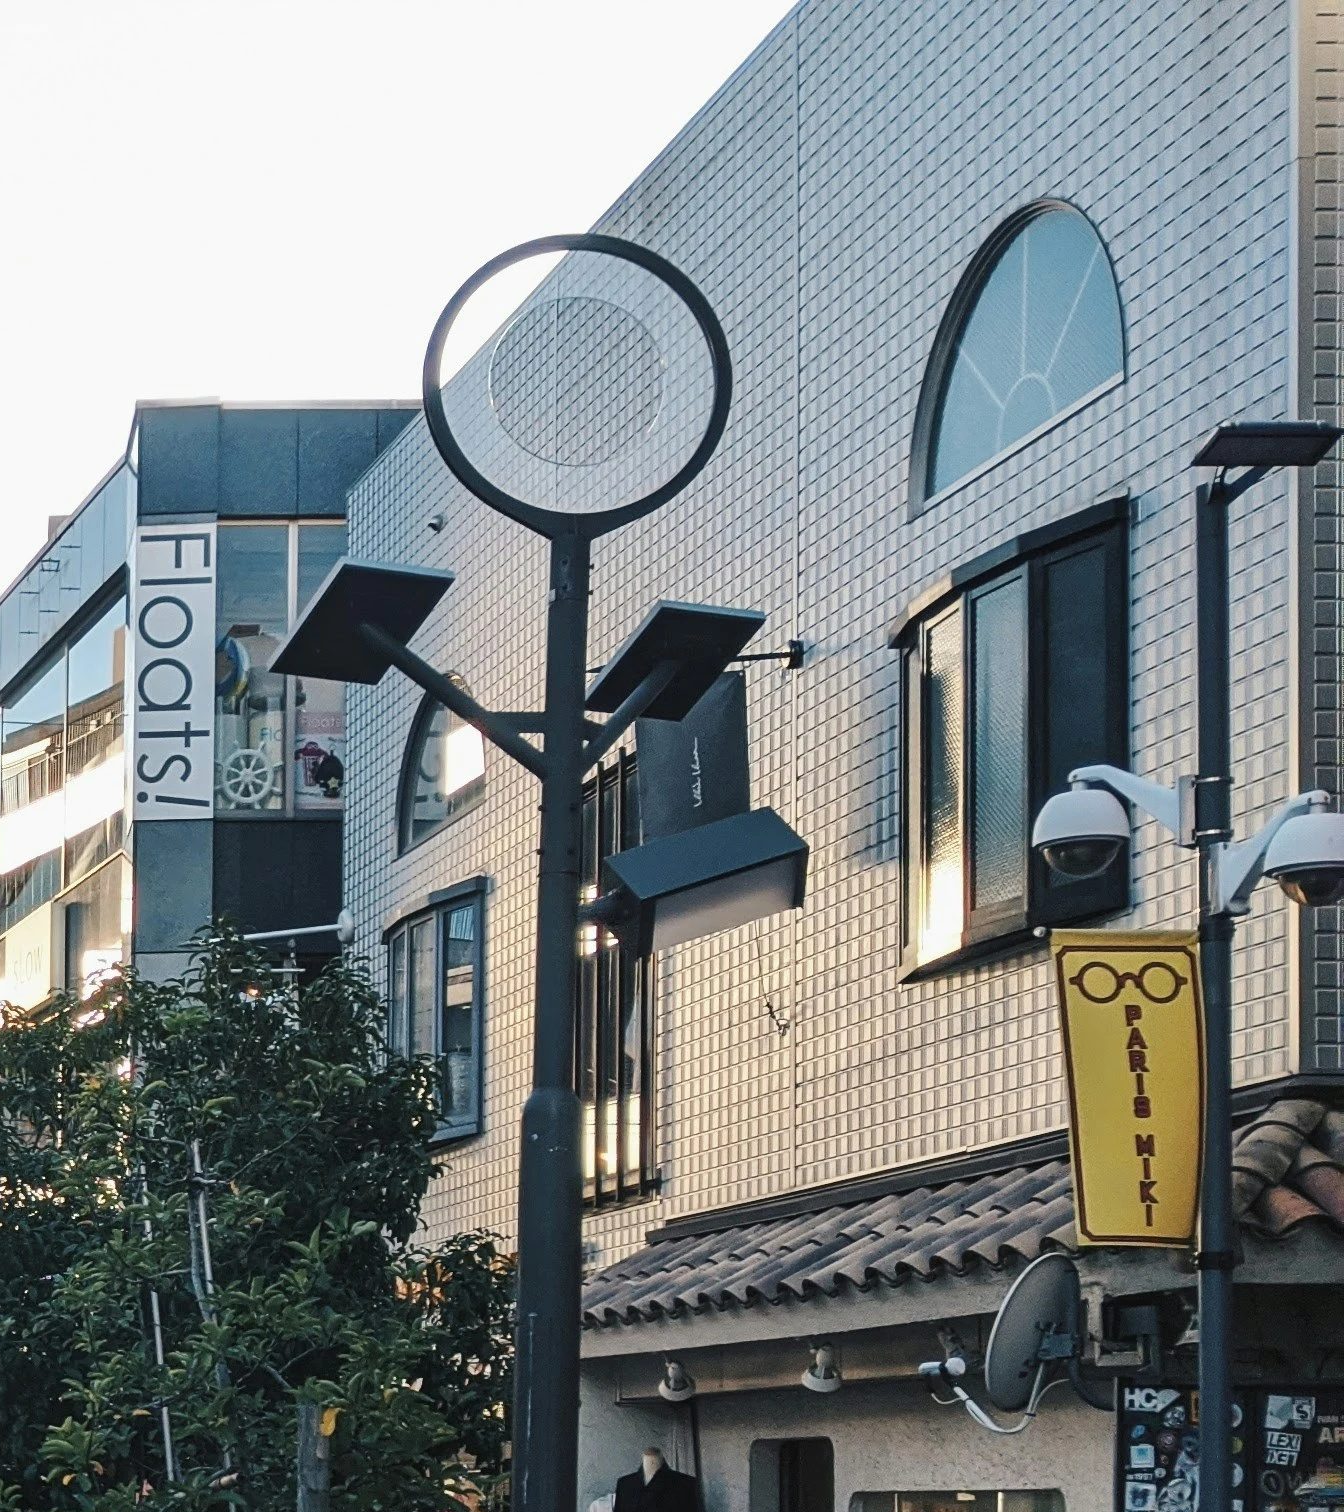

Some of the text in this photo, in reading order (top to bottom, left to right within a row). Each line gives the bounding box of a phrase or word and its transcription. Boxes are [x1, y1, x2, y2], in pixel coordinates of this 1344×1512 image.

[137, 533, 211, 808] Floats!
[1124, 1003, 1159, 1227] PARIS MIKI
